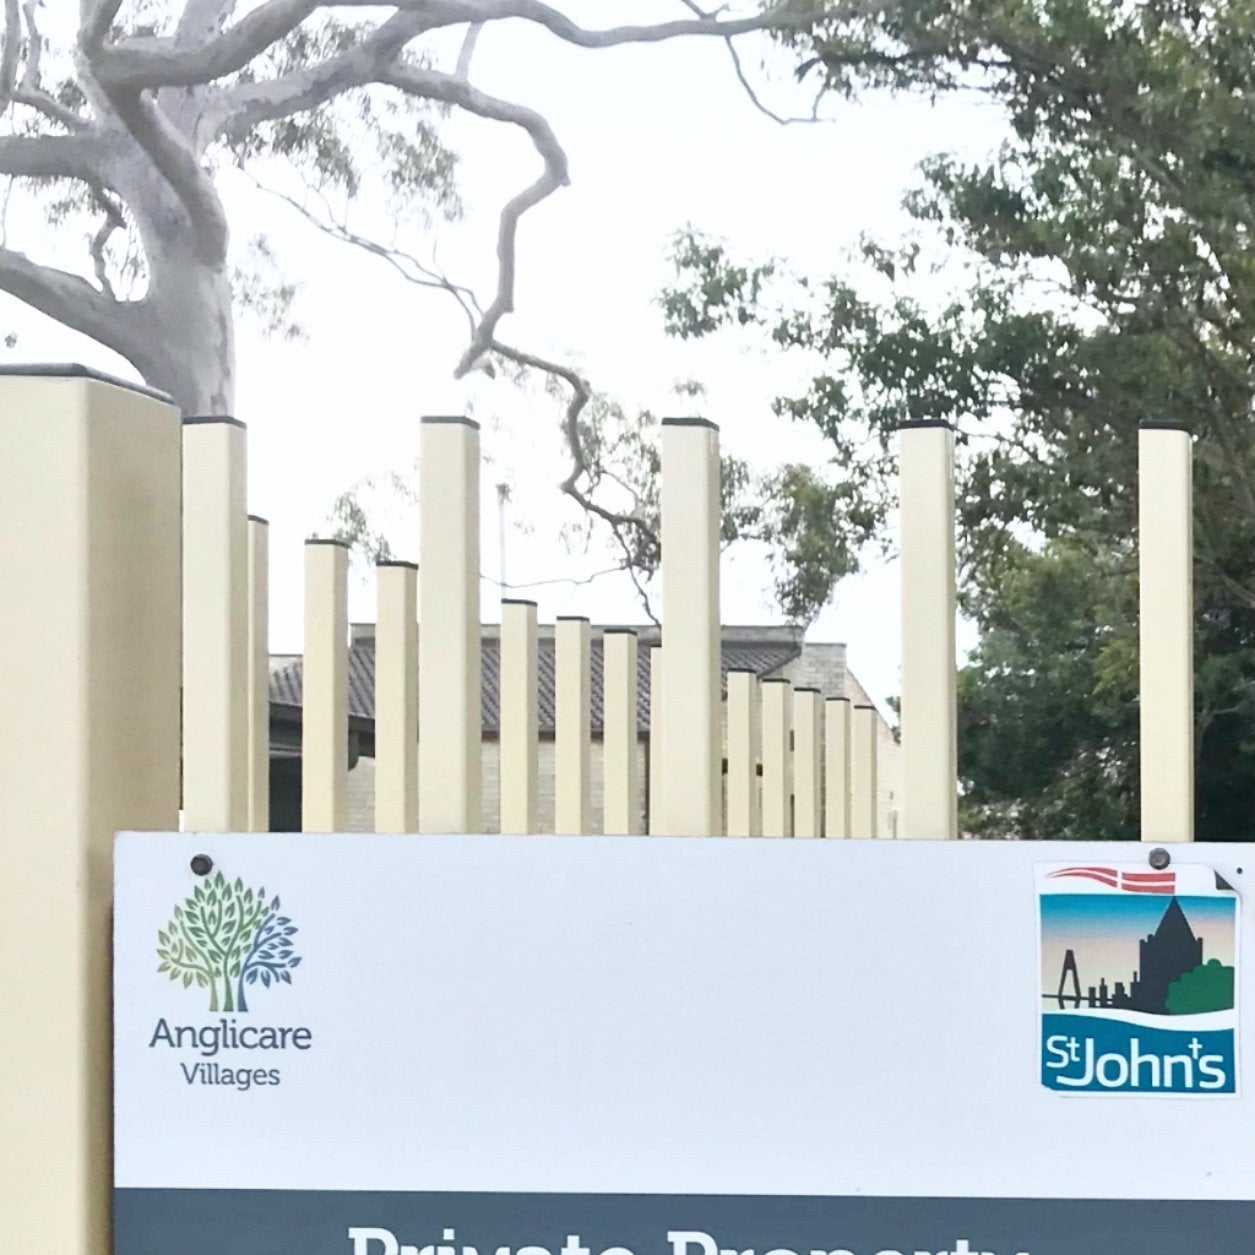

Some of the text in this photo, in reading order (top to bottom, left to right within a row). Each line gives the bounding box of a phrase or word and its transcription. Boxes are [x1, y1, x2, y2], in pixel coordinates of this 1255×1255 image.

[148, 1017, 313, 1057] Anglicare
[1046, 1034, 1081, 1069] St
[179, 1062, 281, 1092] Villages
